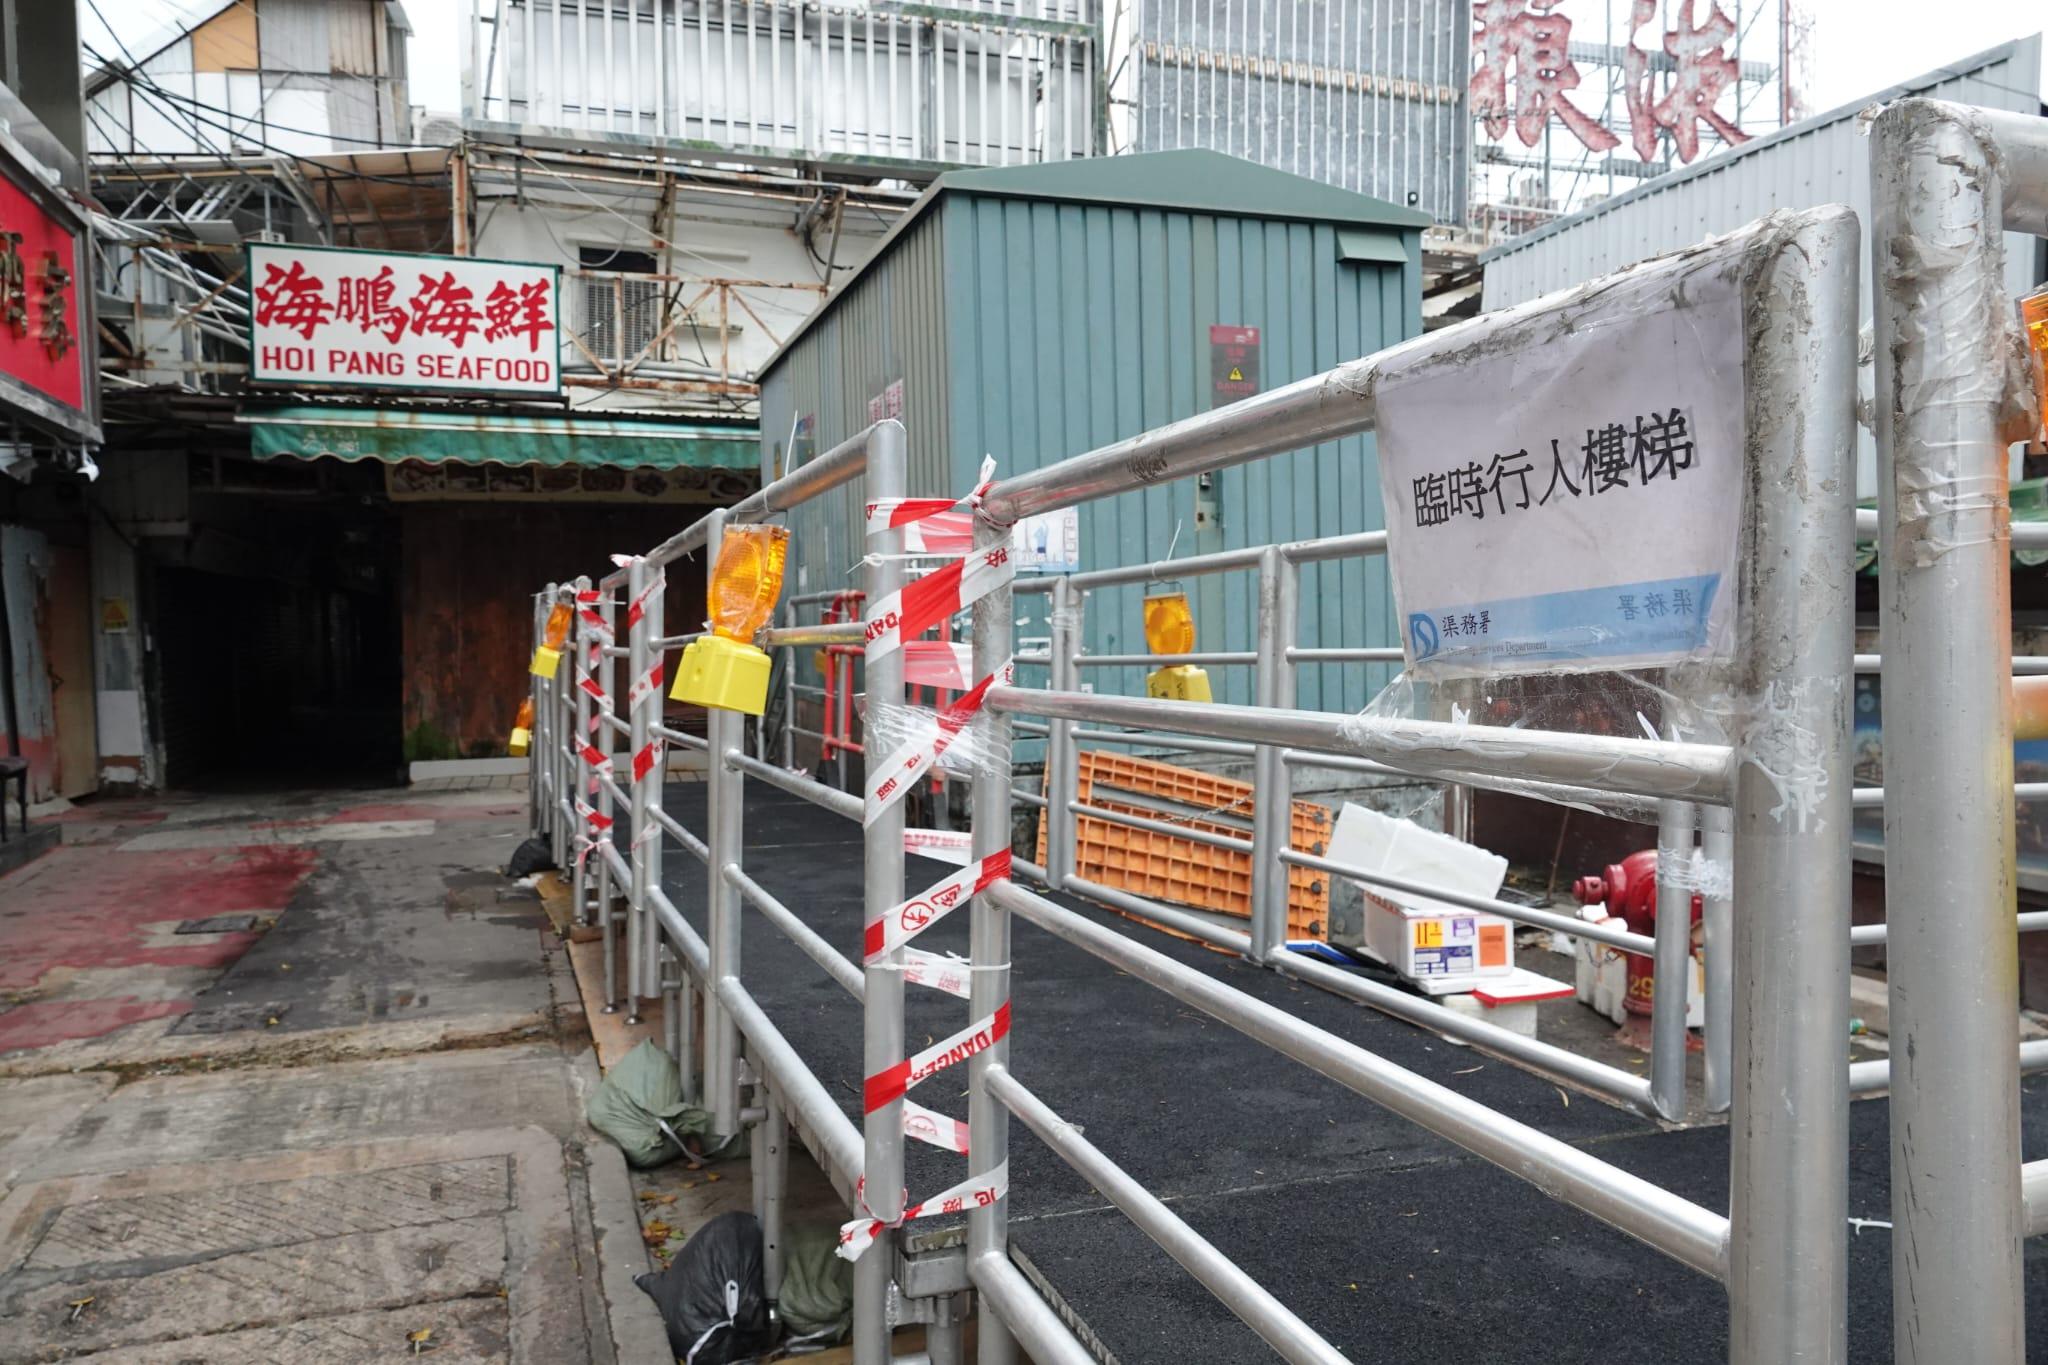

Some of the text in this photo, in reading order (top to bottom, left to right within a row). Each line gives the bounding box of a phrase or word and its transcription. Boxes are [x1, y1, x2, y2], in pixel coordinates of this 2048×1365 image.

[255, 260, 555, 353] 海鵬海鮮
[262, 346, 550, 383] HOI PANG SEAFOOD
[1412, 407, 1694, 527] 臨時行人樓梯
[1442, 610, 1491, 638] 渠務署
